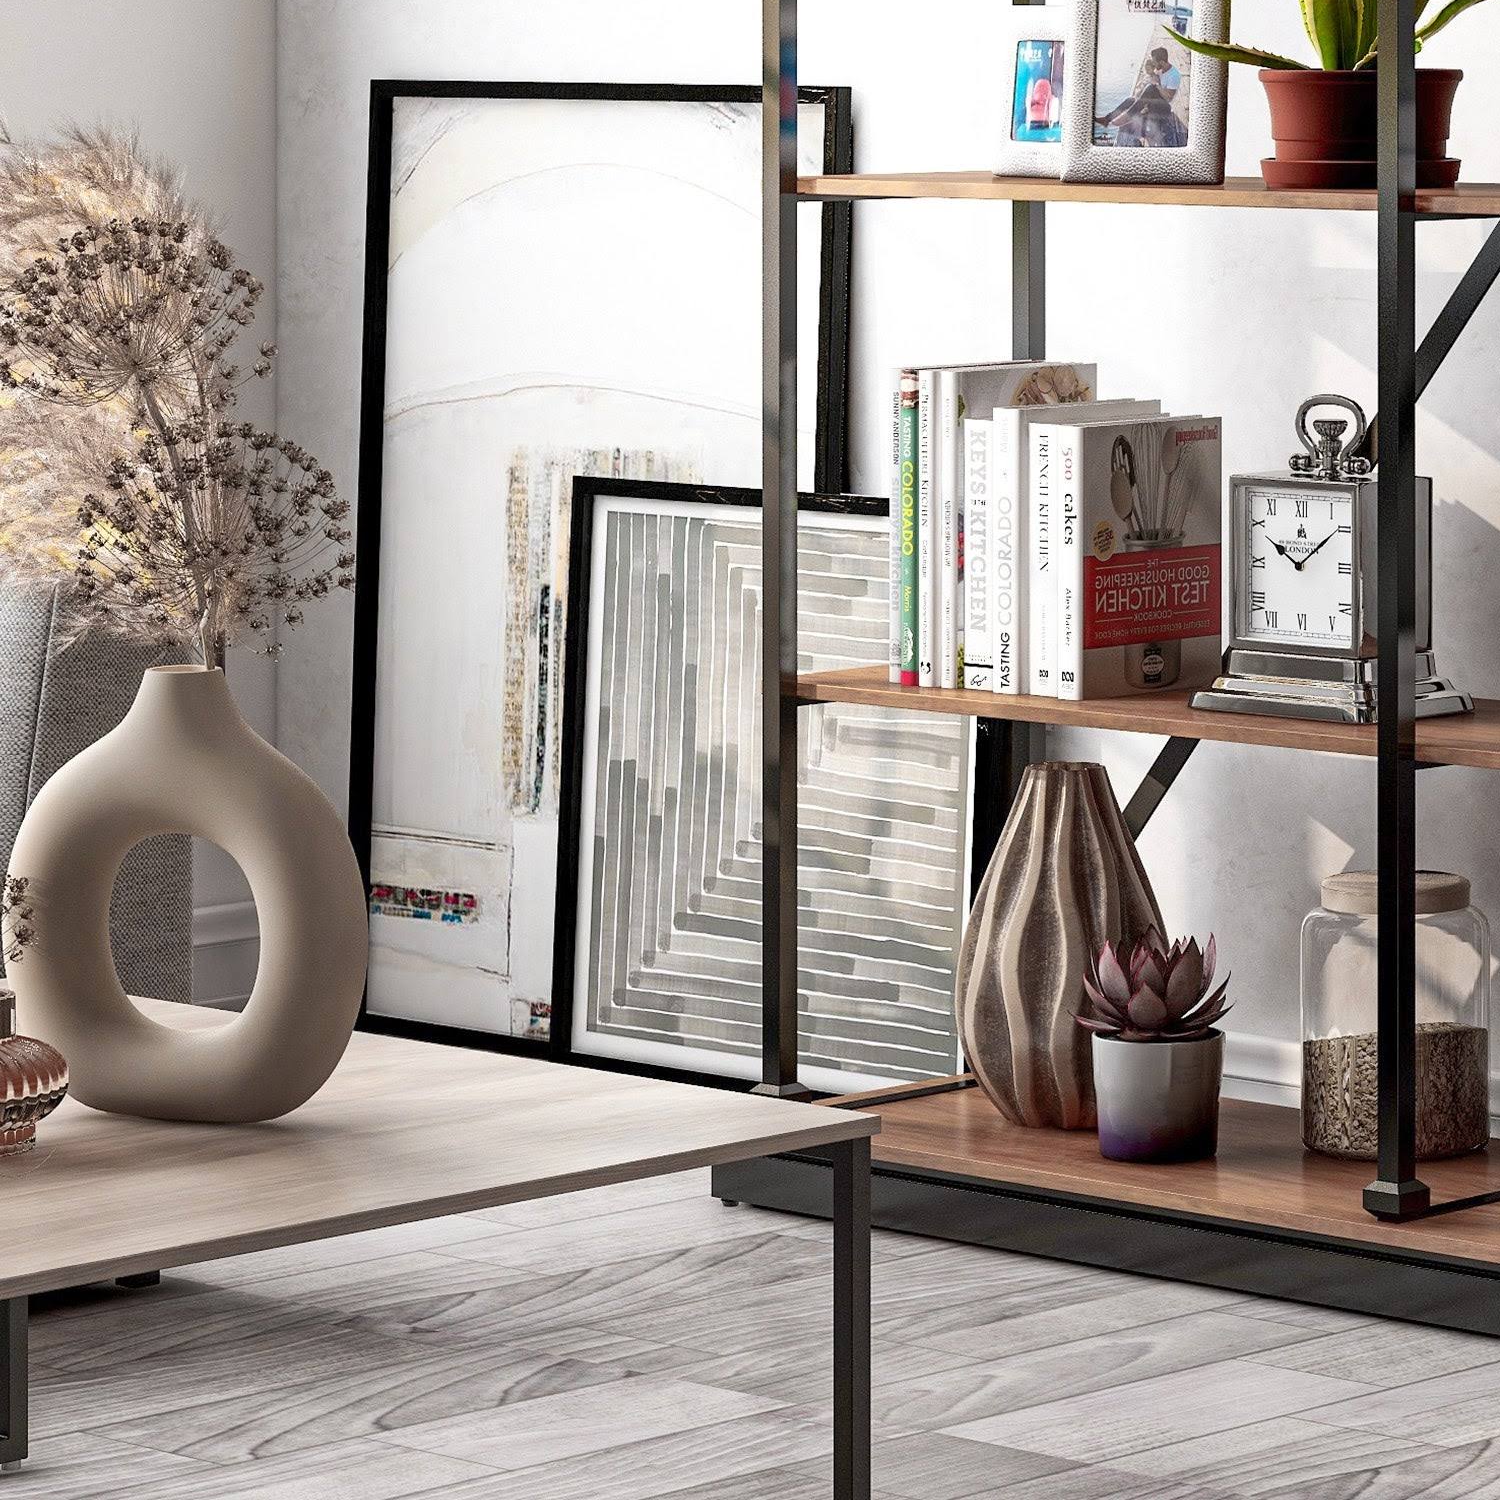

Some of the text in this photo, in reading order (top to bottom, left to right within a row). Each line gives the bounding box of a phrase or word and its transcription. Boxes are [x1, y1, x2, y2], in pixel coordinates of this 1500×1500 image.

[902, 461, 914, 556] COLORADO
[921, 480, 929, 527] KITCHEN
[970, 430, 986, 495] KEYS
[1039, 434, 1048, 572] FRENCH KITCHEN
[1062, 448, 1077, 546] 500 cakes
[904, 585, 912, 613] Morris
[970, 509, 986, 632] KITCHEN
[998, 496, 1012, 689] TASTING COLORADO
